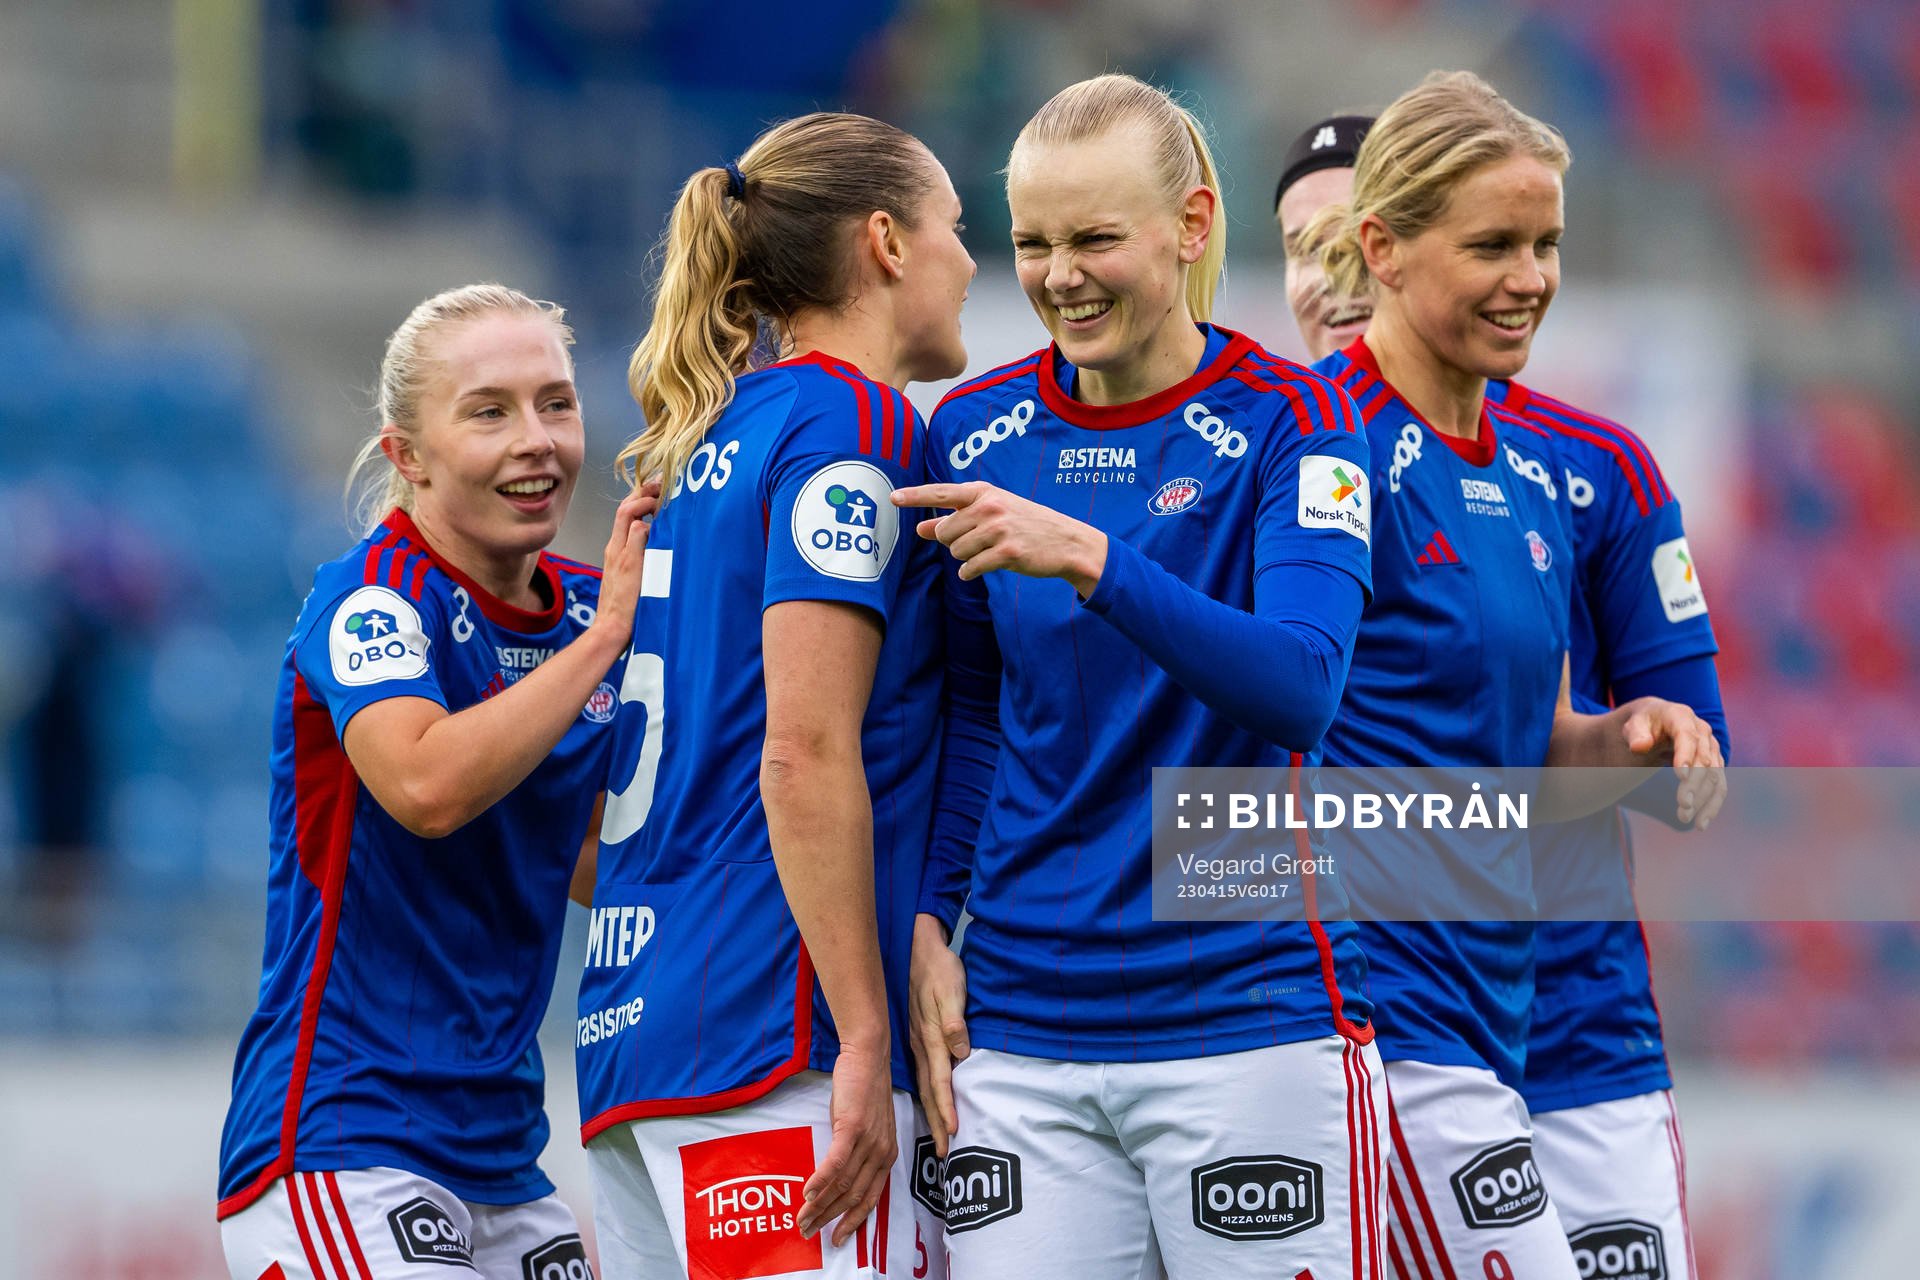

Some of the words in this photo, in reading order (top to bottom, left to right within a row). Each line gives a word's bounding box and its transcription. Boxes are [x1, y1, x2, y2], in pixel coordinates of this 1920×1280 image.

[949, 399, 1035, 470] coop
[1183, 402, 1248, 458] cop
[1076, 448, 1136, 468] STENA
[1056, 472, 1135, 484] RECYCLING
[1305, 506, 1344, 521] Norsk
[1345, 511, 1369, 538] Tipp
[811, 528, 879, 562] OBOS
[349, 640, 420, 671] OBO
[695, 1174, 805, 1217] THON
[1207, 1174, 1306, 1212] ooni
[1474, 1160, 1540, 1206] oon
[958, 1203, 988, 1215] OVENS
[1221, 1215, 1254, 1225] PIZZA
[1255, 1213, 1294, 1223] OVENS
[709, 1212, 794, 1240] HOTELS
